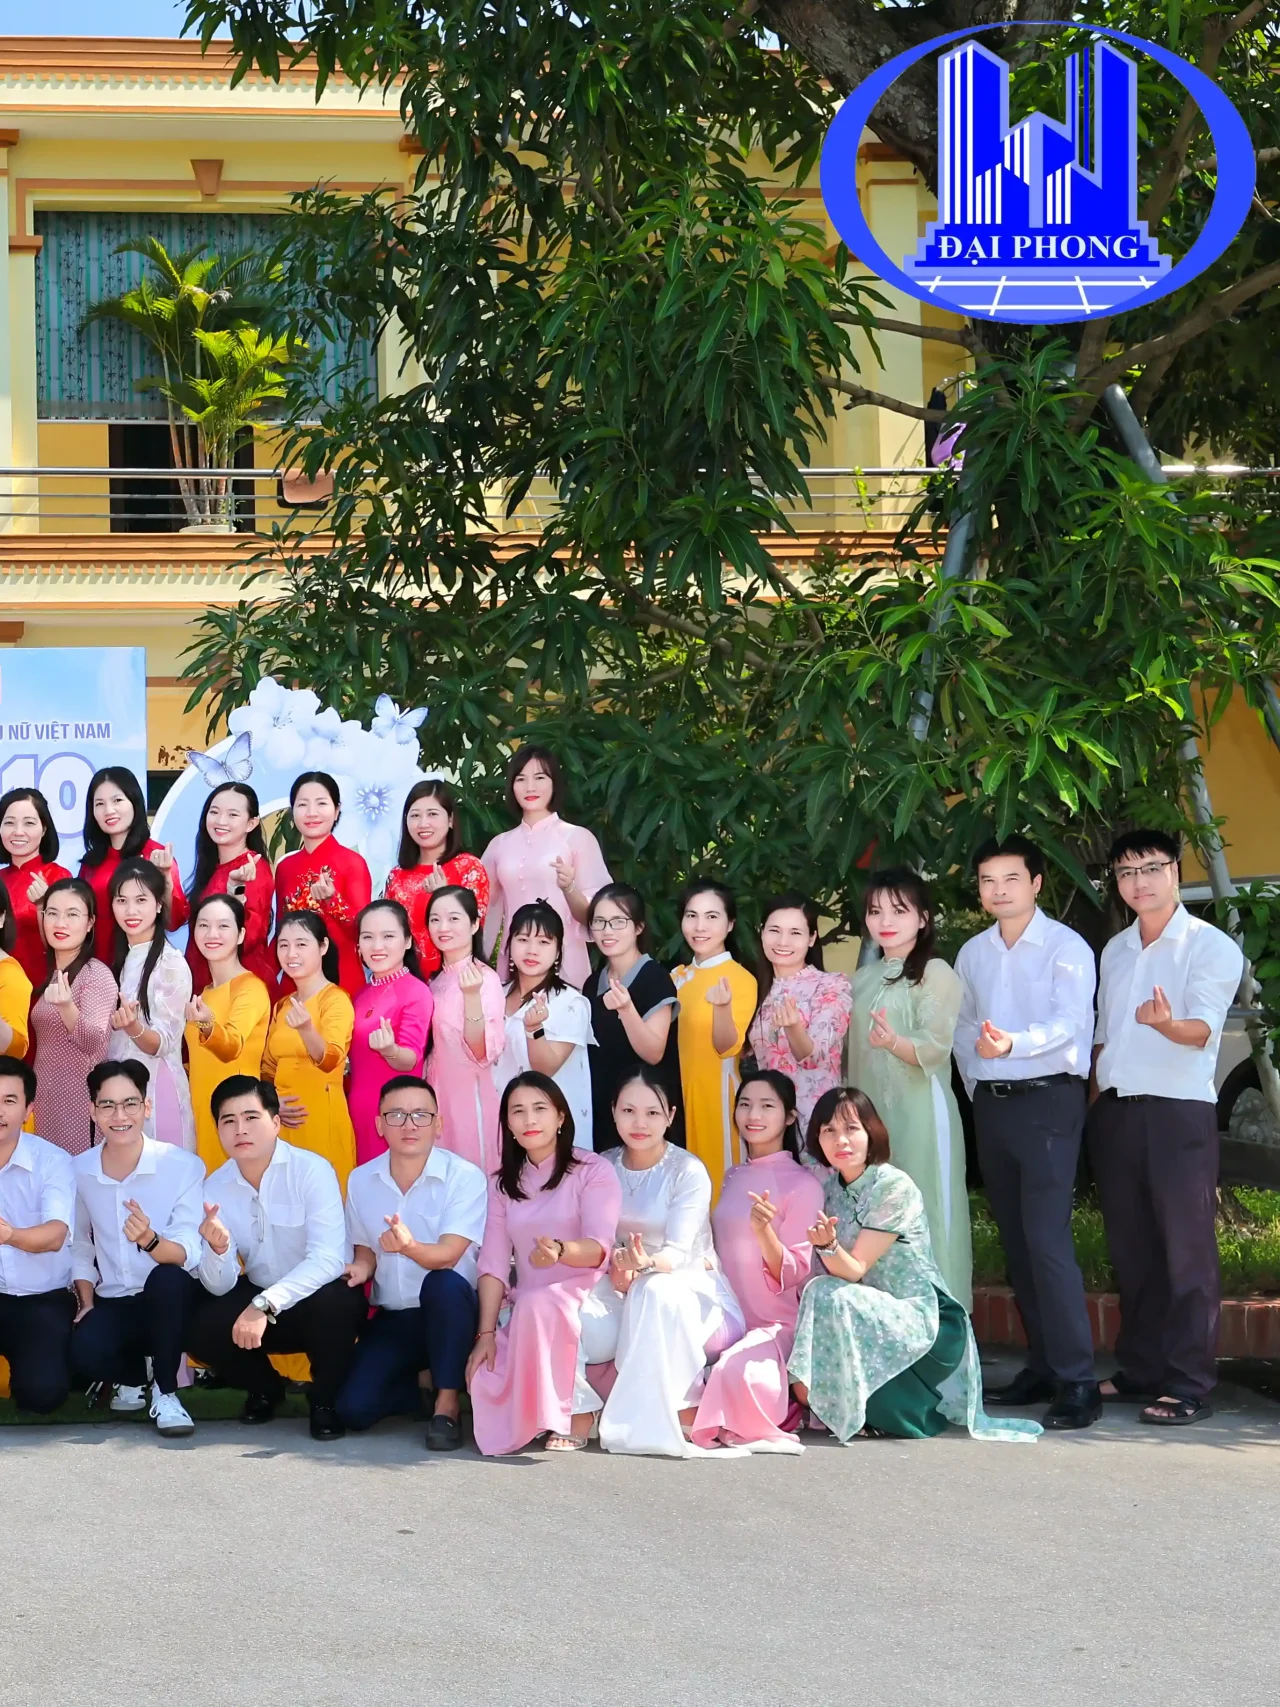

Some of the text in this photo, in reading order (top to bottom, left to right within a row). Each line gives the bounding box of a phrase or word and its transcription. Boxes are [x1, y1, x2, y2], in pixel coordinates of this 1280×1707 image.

[8, 721, 32, 741] NỮ
[34, 720, 70, 743] VIỆT
[74, 723, 111, 740] NAM
